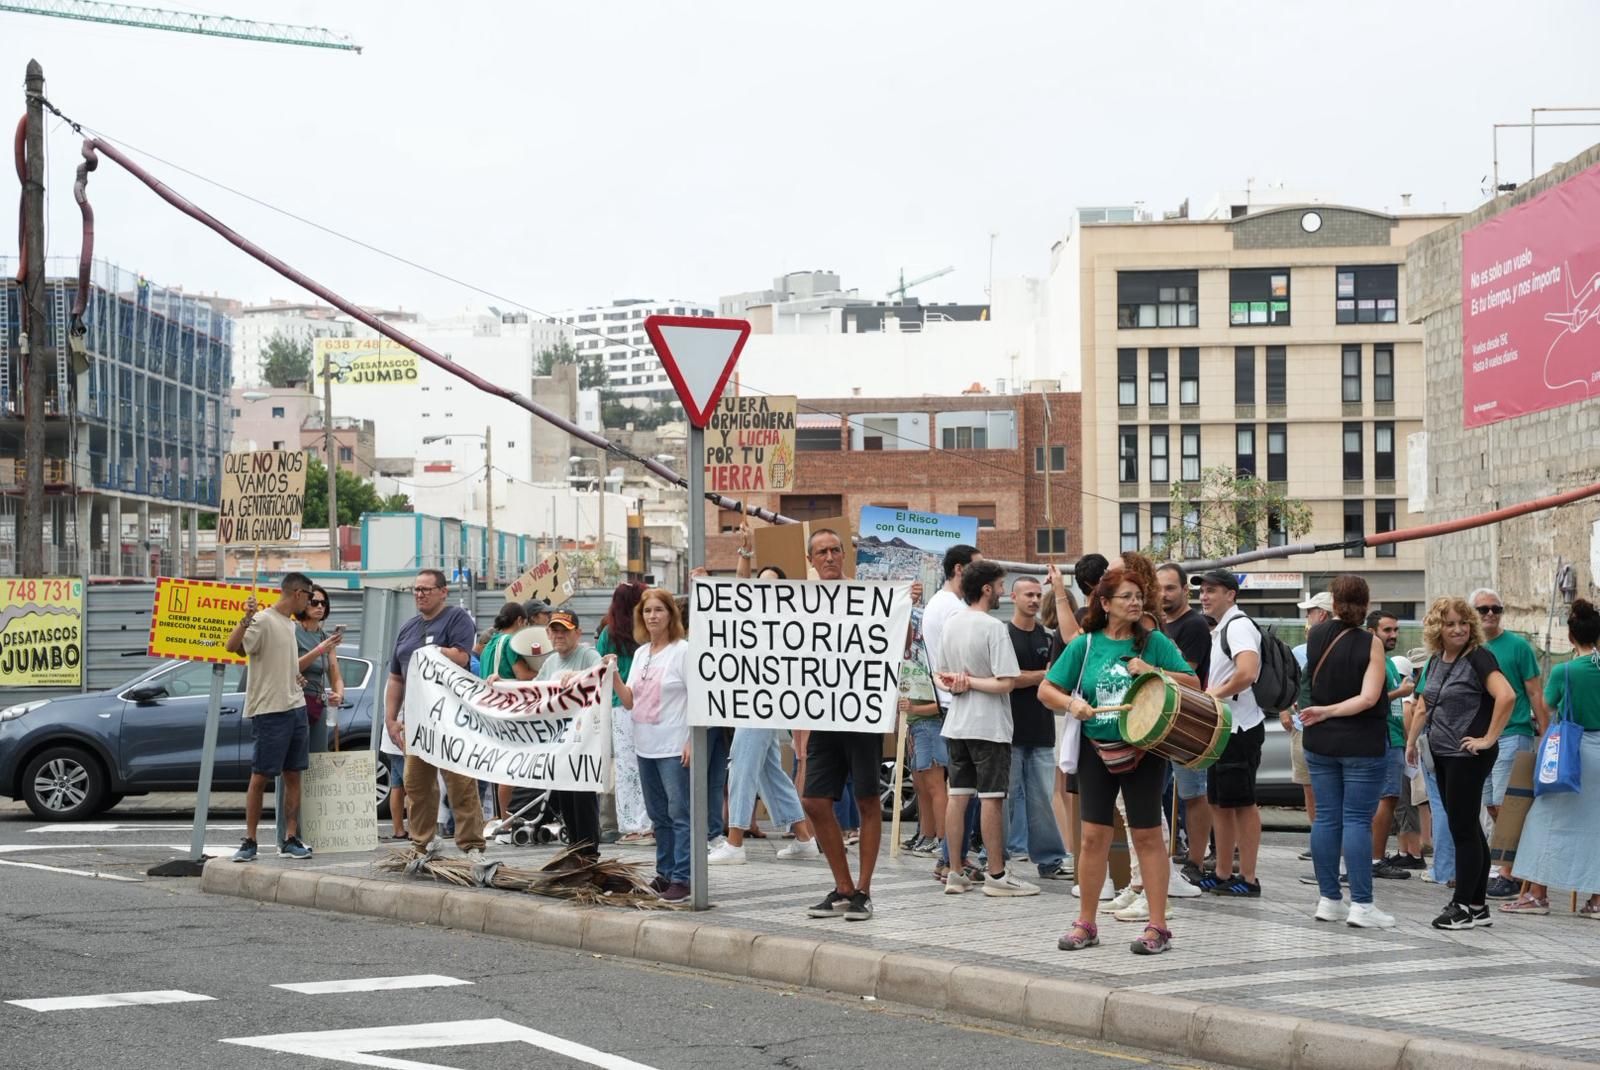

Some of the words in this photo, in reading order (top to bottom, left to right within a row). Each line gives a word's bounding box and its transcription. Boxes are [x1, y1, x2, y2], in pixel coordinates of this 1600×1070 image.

[1470, 271, 1480, 290] No
[1480, 269, 1489, 283] es
[1489, 260, 1502, 282] solo
[1503, 259, 1512, 276] un
[1513, 247, 1533, 271] vuelo
[1471, 298, 1480, 316] Es
[1479, 297, 1488, 312] tu
[1512, 284, 1518, 304] y
[1518, 279, 1531, 298] nos
[324, 339, 350, 350] 638
[355, 339, 380, 350] 748
[385, 339, 403, 350] 73
[353, 358, 416, 370] DESATASCOS
[353, 368, 418, 383] JUMBO
[714, 396, 770, 413] FUERA
[720, 430, 730, 447] Y
[738, 430, 780, 447] LUCHA
[225, 453, 250, 474] QUE
[252, 452, 272, 474] NO
[277, 451, 303, 473] NOS
[707, 447, 734, 464] POR
[741, 446, 764, 464] TU
[236, 473, 288, 494] VAMOS
[220, 499, 234, 517] LA
[239, 487, 304, 517] GENTRIFICACIÓN
[896, 511, 906, 521] El
[908, 512, 938, 525] Risco
[218, 517, 234, 544] NO
[235, 518, 249, 541] HA
[251, 517, 292, 541] GANADO
[875, 523, 895, 532] con
[897, 523, 961, 539] Guanarteme
[7, 580, 36, 601] 748
[42, 580, 71, 601] 731
[696, 582, 894, 618] DESTRUYEN
[168, 614, 191, 622] CIERRE
[203, 617, 225, 625] CARRIL
[197, 624, 222, 633] SALIDA
[3, 626, 78, 647] DESATASCOS
[708, 619, 889, 654] HISTORIAS
[1, 643, 80, 675] JUMBO
[698, 651, 901, 692] CONSTRUYEN
[429, 696, 446, 721] A
[707, 689, 883, 724] NEGOCIOS
[441, 734, 465, 763] NO
[466, 744, 509, 773] HAY
[506, 751, 555, 781] QUIEN
[568, 754, 603, 784] VIV
